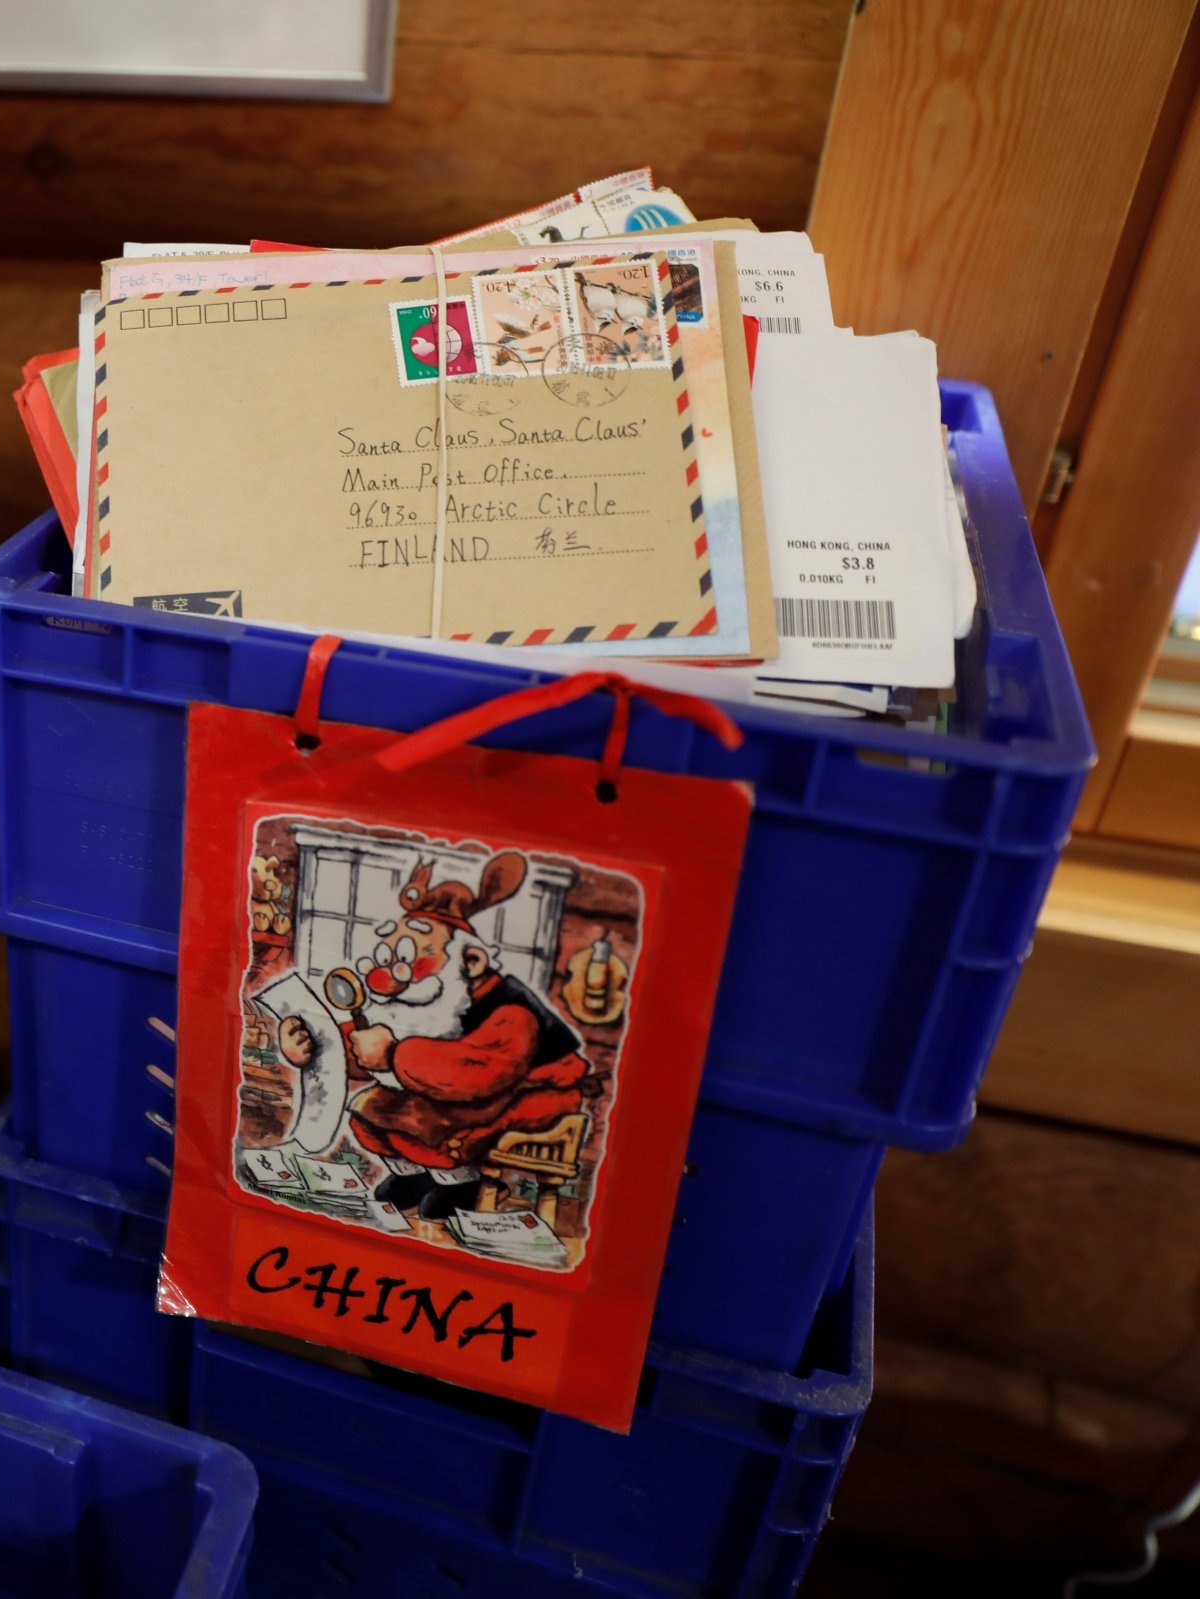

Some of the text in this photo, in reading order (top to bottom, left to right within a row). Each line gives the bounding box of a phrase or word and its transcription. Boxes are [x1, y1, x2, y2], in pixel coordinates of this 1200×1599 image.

[767, 269, 796, 277] CHINA
[754, 280, 784, 292] $6.6
[423, 306, 437, 319] 60
[337, 427, 402, 456] Santa
[499, 417, 565, 444] Santa
[342, 467, 400, 493] Main
[349, 483, 617, 527] 96930 Arctic Circle
[787, 540, 891, 552] HONG KONG, CHINA
[842, 557, 875, 570] $3.8
[799, 573, 876, 585] 0.010KG FI
[151, 597, 189, 612] 航空
[246, 1246, 538, 1363] CHINA
